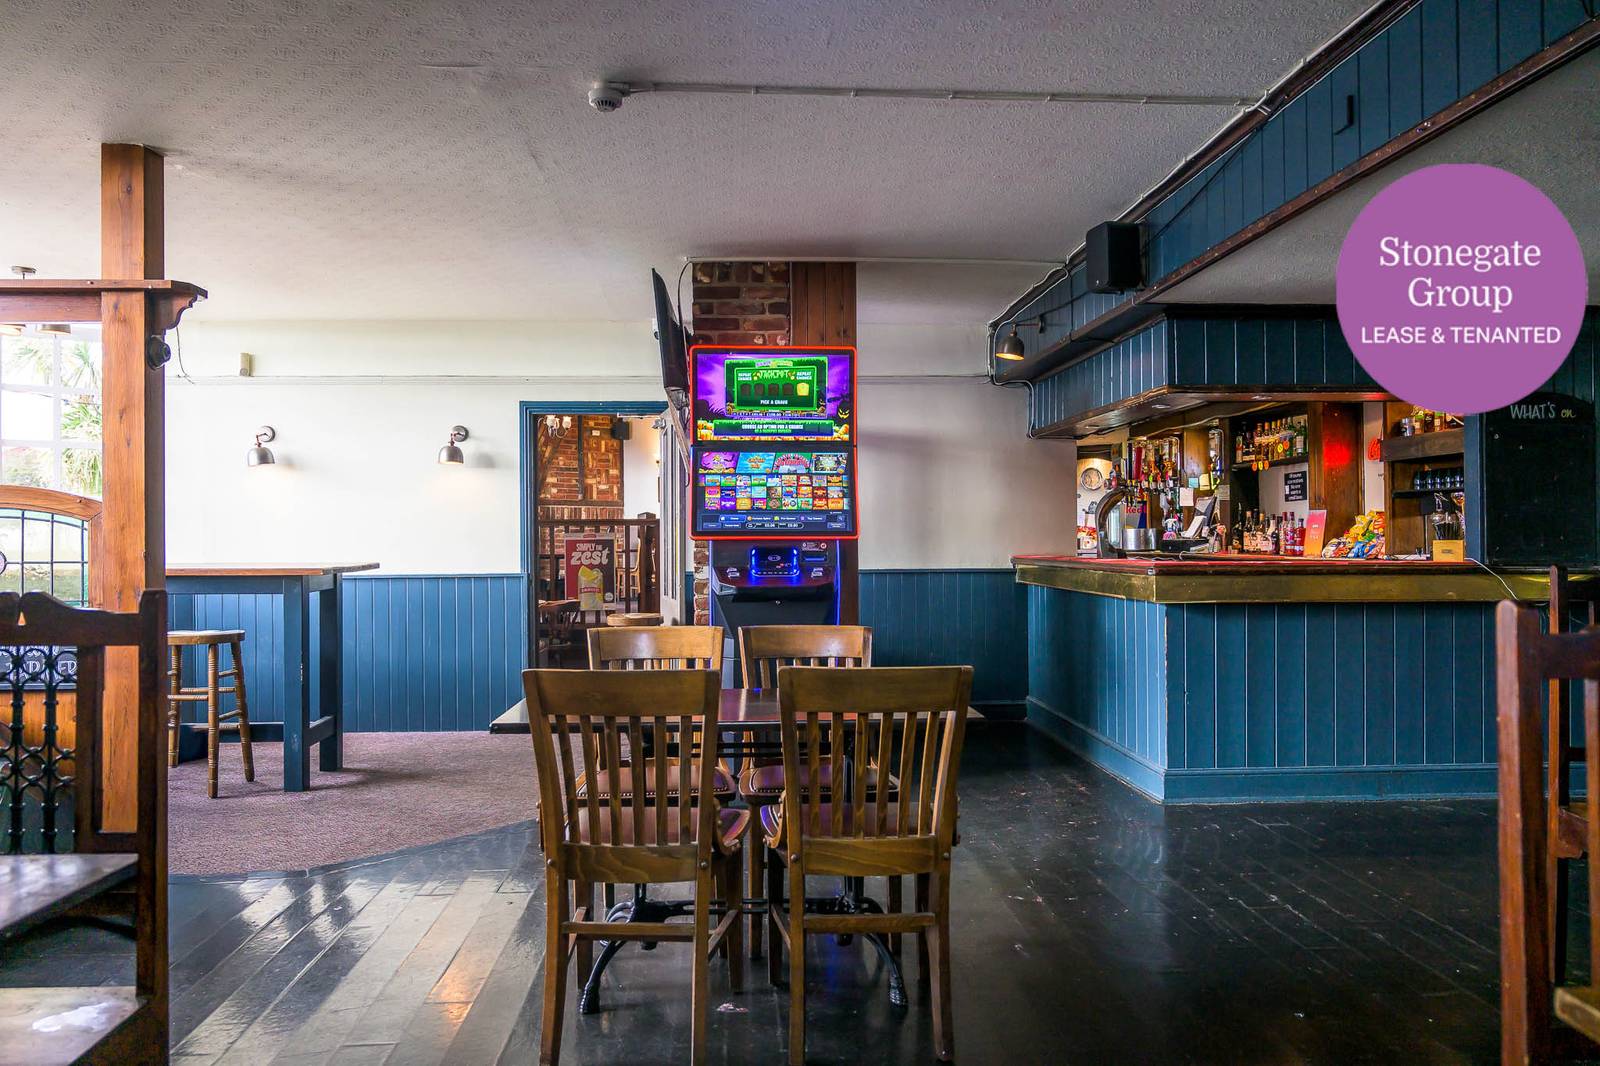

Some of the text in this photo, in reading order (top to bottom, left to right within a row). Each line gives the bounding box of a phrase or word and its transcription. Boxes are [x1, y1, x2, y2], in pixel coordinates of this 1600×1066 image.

[1510, 401, 1577, 420] WHAT'S on
[570, 547, 610, 565] zest
[576, 542, 595, 552] SIMPLY
